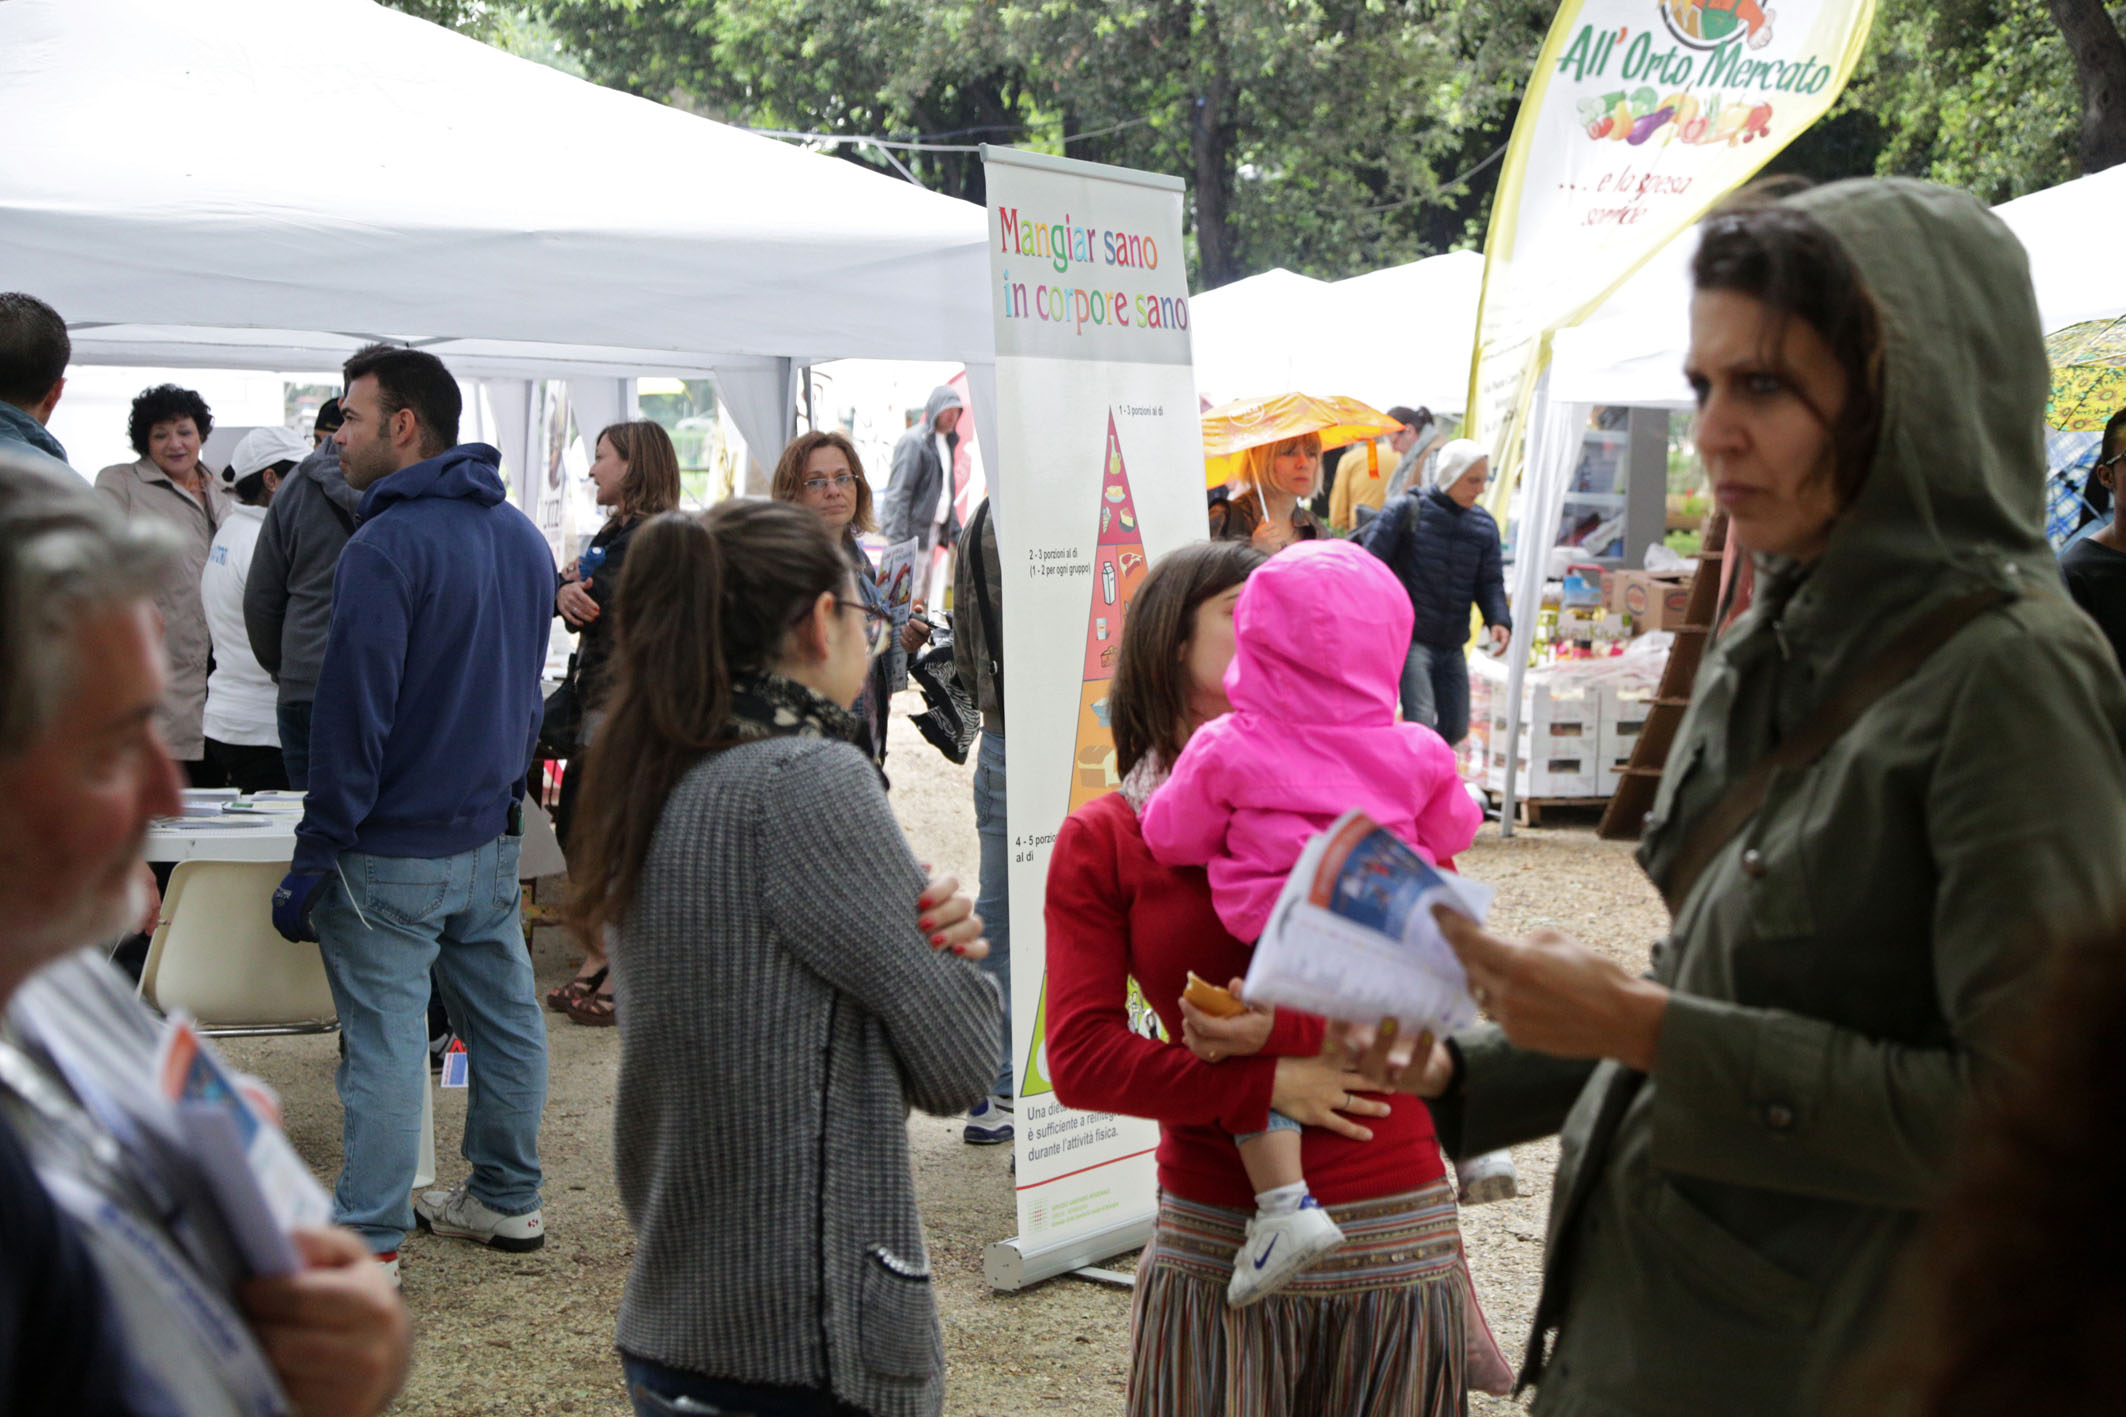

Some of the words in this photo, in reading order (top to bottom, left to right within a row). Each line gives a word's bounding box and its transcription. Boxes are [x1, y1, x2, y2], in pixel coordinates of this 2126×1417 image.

[1696, 40, 1831, 95] Mercato
[998, 206, 1096, 272] Mangiar
[1104, 230, 1158, 270] sano
[1003, 269, 1029, 318] in
[1036, 283, 1129, 335] corpore
[1135, 293, 1188, 330] sano
[1029, 549, 1034, 560] 2
[1038, 549, 1043, 560] 3
[1043, 548, 1066, 561] porzioni
[1066, 548, 1071, 559] al
[1030, 564, 1036, 578] (1
[1041, 564, 1045, 575] 2
[1046, 566, 1055, 578] per
[1056, 563, 1069, 577] ogni
[1069, 562, 1091, 577] gruppo)
[1016, 836, 1021, 847] 4
[1029, 835, 1034, 846] 5
[1035, 832, 1057, 847] porzio
[1016, 851, 1024, 863] al
[1027, 1106, 1046, 1120] Una
[1027, 1128, 1034, 1141] è
[1036, 1117, 1078, 1140] sufficiente
[1080, 1116, 1085, 1127] a
[1028, 1145, 1061, 1161] durante
[1062, 1131, 1094, 1152] l'attività
[1095, 1127, 1119, 1142] fisica.
